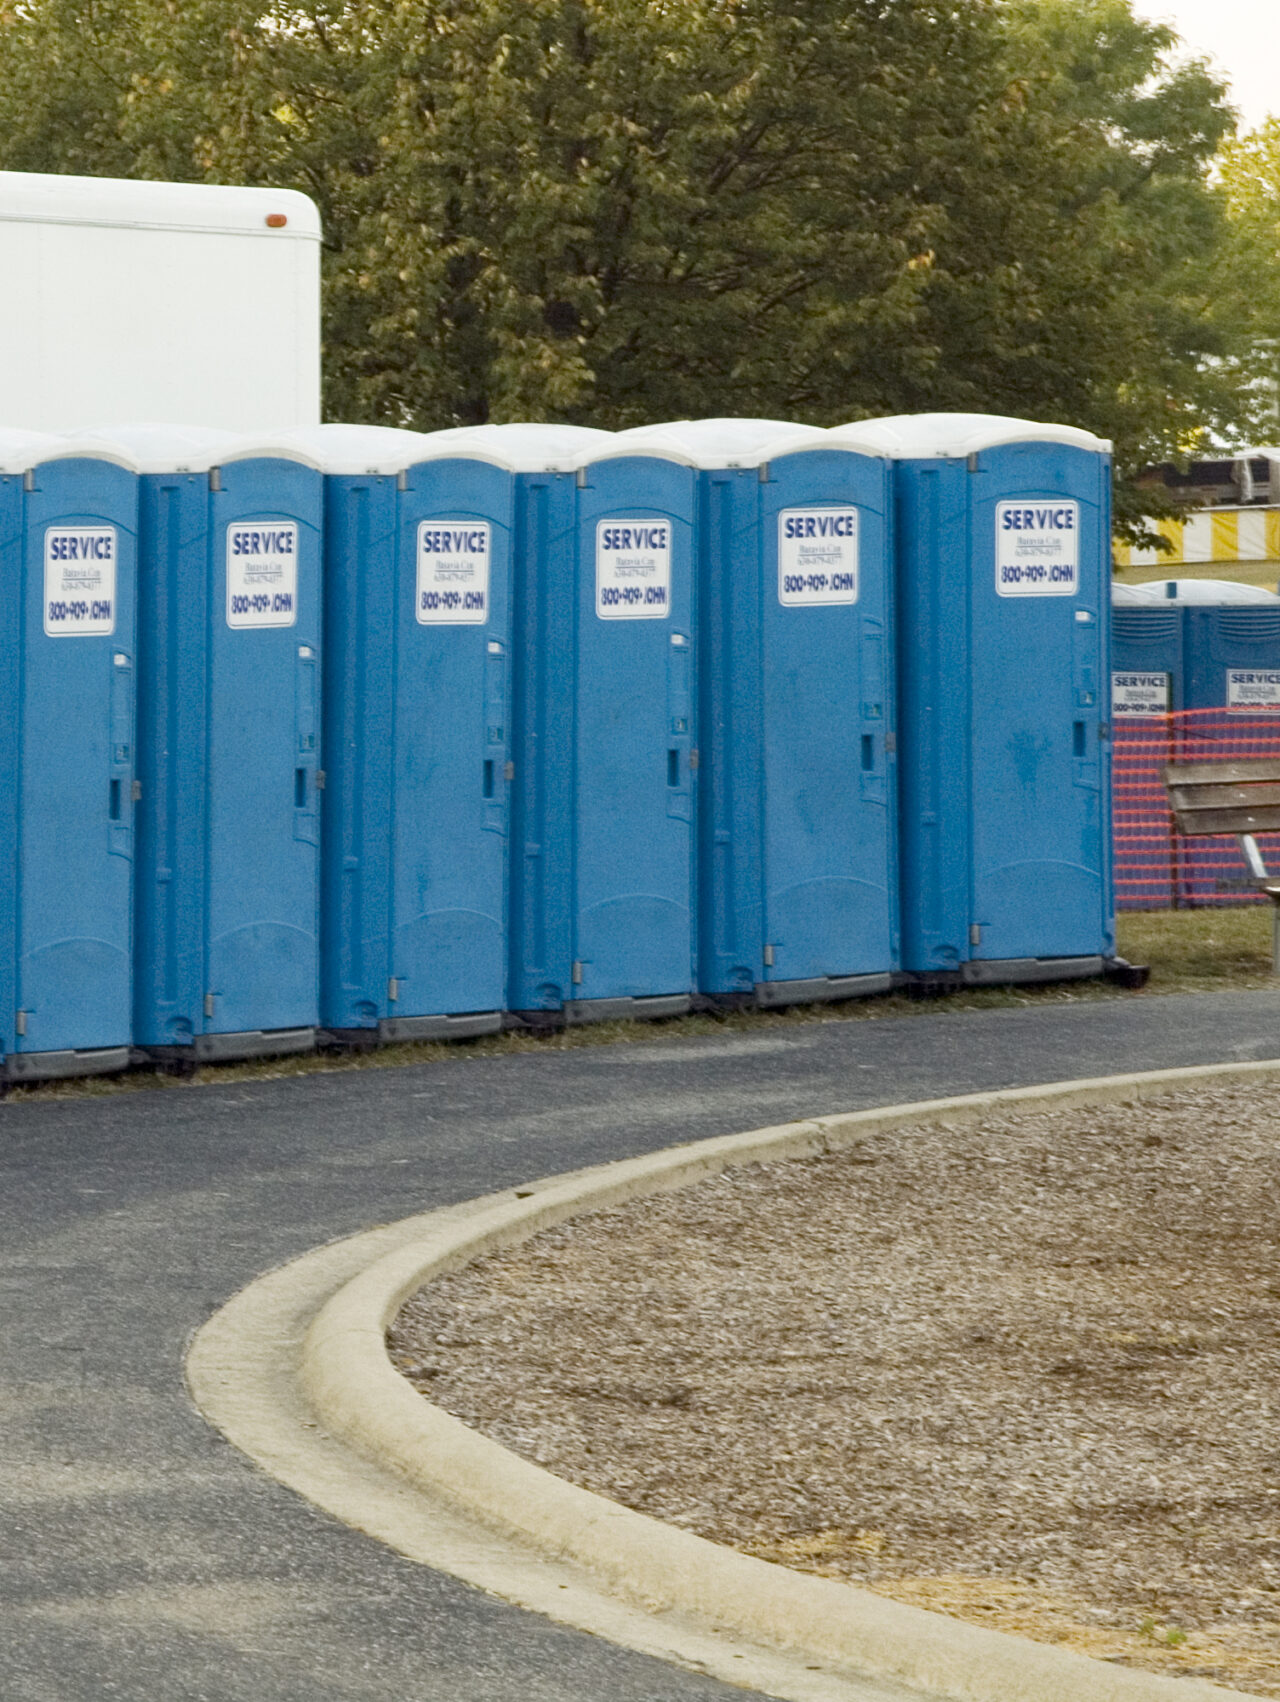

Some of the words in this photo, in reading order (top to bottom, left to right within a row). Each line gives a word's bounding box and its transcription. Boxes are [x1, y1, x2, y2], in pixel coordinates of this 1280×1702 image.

[785, 516, 853, 538] SERVICE
[1003, 509, 1073, 530] SERVICE
[50, 536, 112, 560] SERVICE
[233, 531, 293, 555] SERVICE
[424, 531, 486, 553] SERVICE
[603, 528, 666, 550] SERVICE
[1114, 677, 1165, 687] SERVICE
